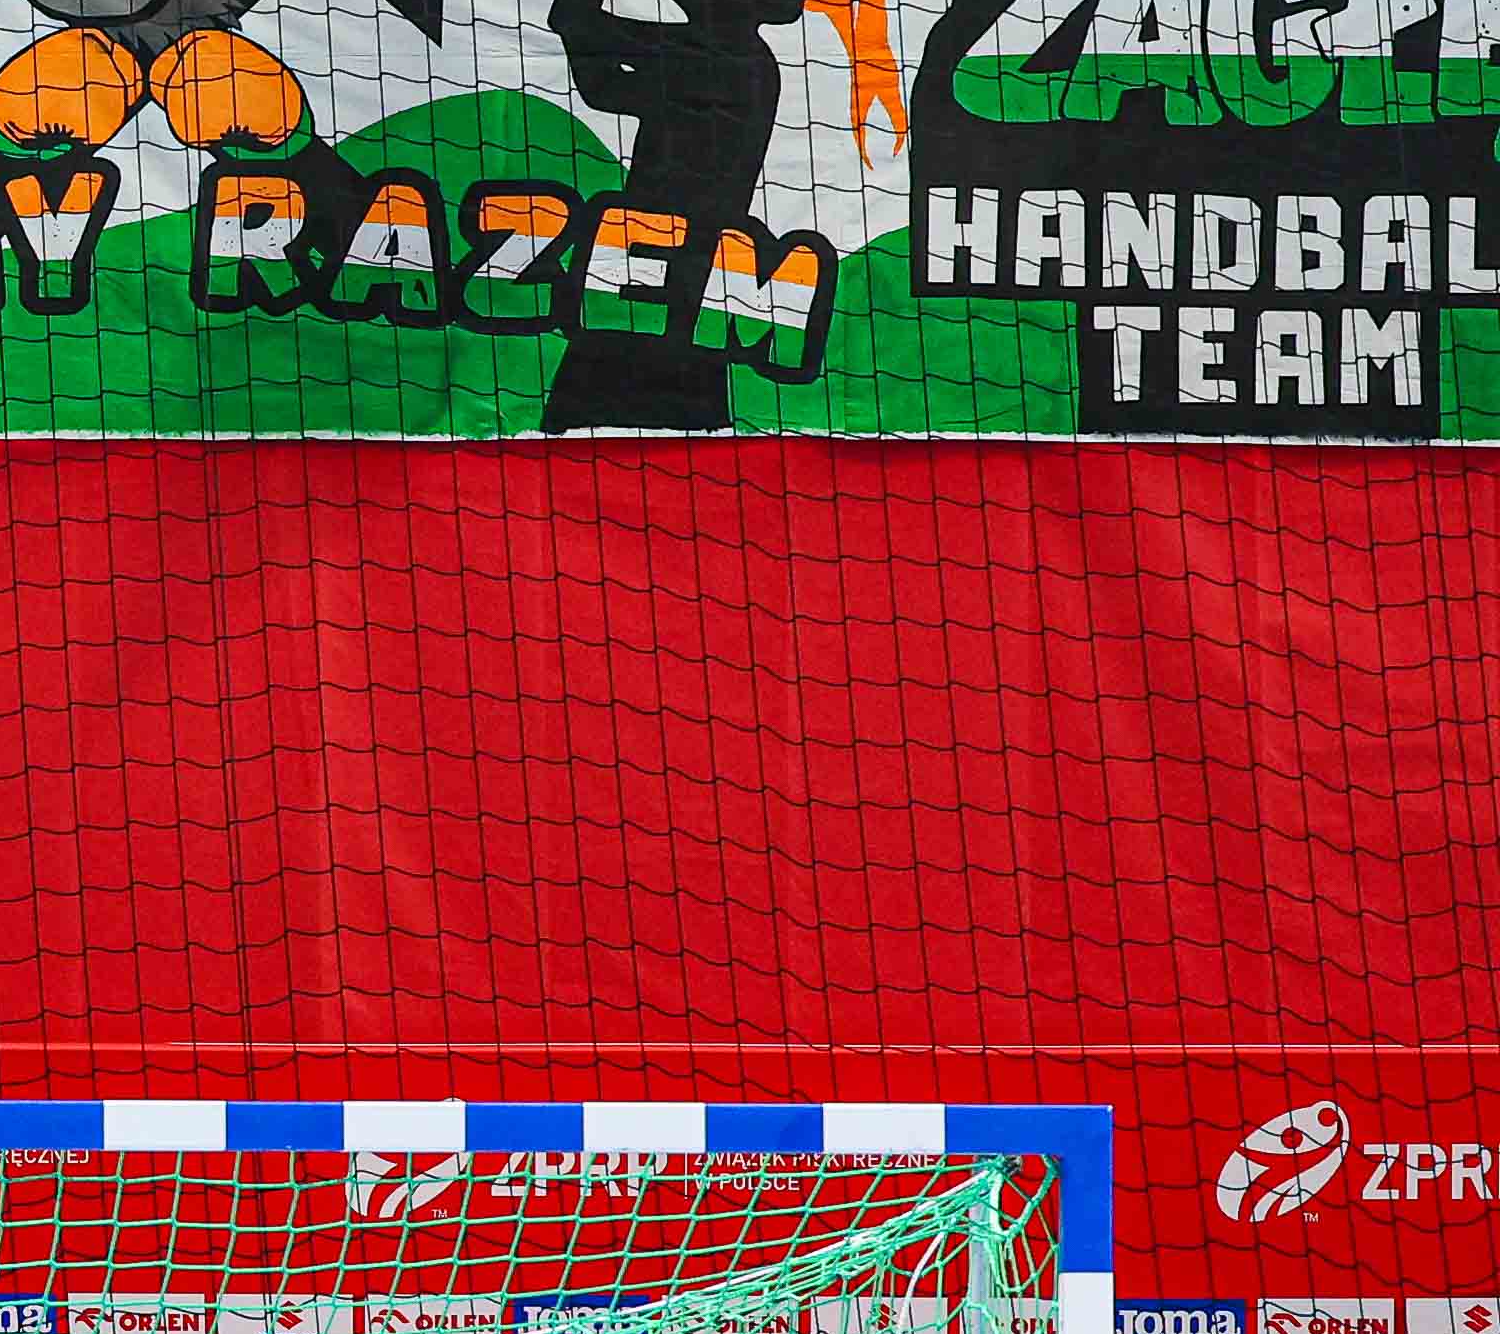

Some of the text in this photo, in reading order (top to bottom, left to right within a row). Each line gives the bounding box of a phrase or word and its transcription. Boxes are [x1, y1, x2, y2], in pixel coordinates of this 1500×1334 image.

[205, 172, 825, 377] RAZEM
[1094, 305, 1422, 405] TEAM
[491, 1153, 667, 1197] ZPRP
[851, 1153, 942, 1169] RĘCZNE
[1362, 1143, 1500, 1200] ZPR
[1303, 1213, 1319, 1222] TM
[119, 1313, 200, 1331] ORLEN
[415, 1313, 496, 1331] ORLEN
